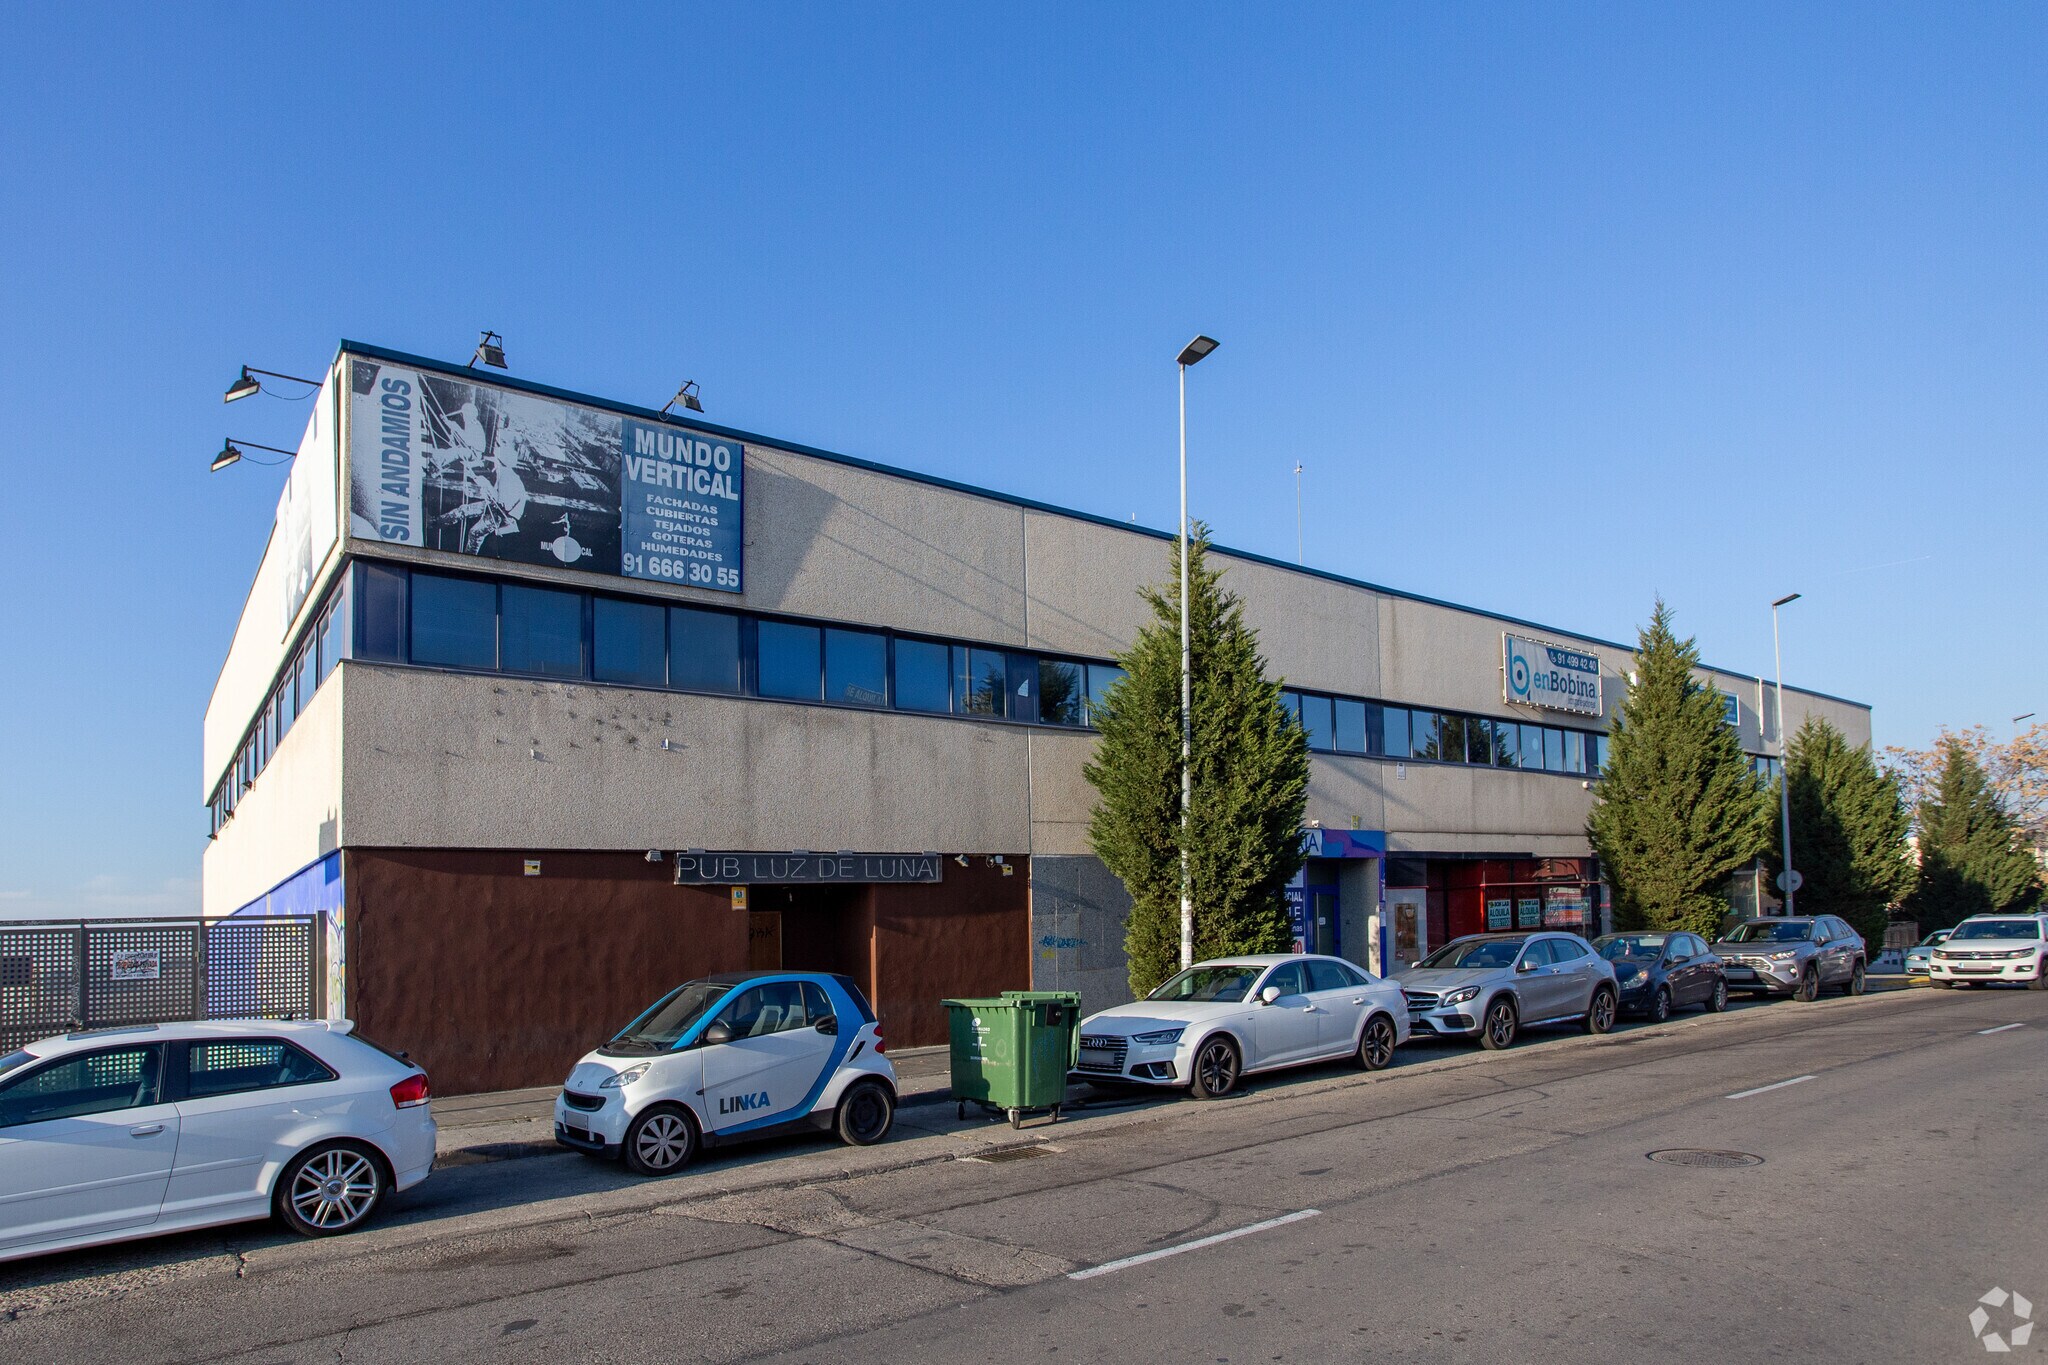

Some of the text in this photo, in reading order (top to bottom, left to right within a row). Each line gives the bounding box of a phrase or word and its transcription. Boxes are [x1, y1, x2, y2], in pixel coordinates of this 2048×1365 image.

[380, 378, 411, 541] SIN ANDAMIOS
[635, 428, 731, 472] MUNDO
[625, 454, 739, 501] VERTICAL
[646, 493, 718, 515] FACHADAS
[646, 506, 719, 526] CUBIERTAS
[653, 519, 711, 537] TEJADOS
[651, 531, 713, 549] GOTERAS
[641, 541, 723, 562] HUMEDADES
[623, 552, 739, 587] 91 666 30 55
[1557, 653, 1597, 671] 91 499 42 40
[677, 856, 934, 879] PUB LUZ DE LUNA
[719, 1091, 771, 1115] LINKA
